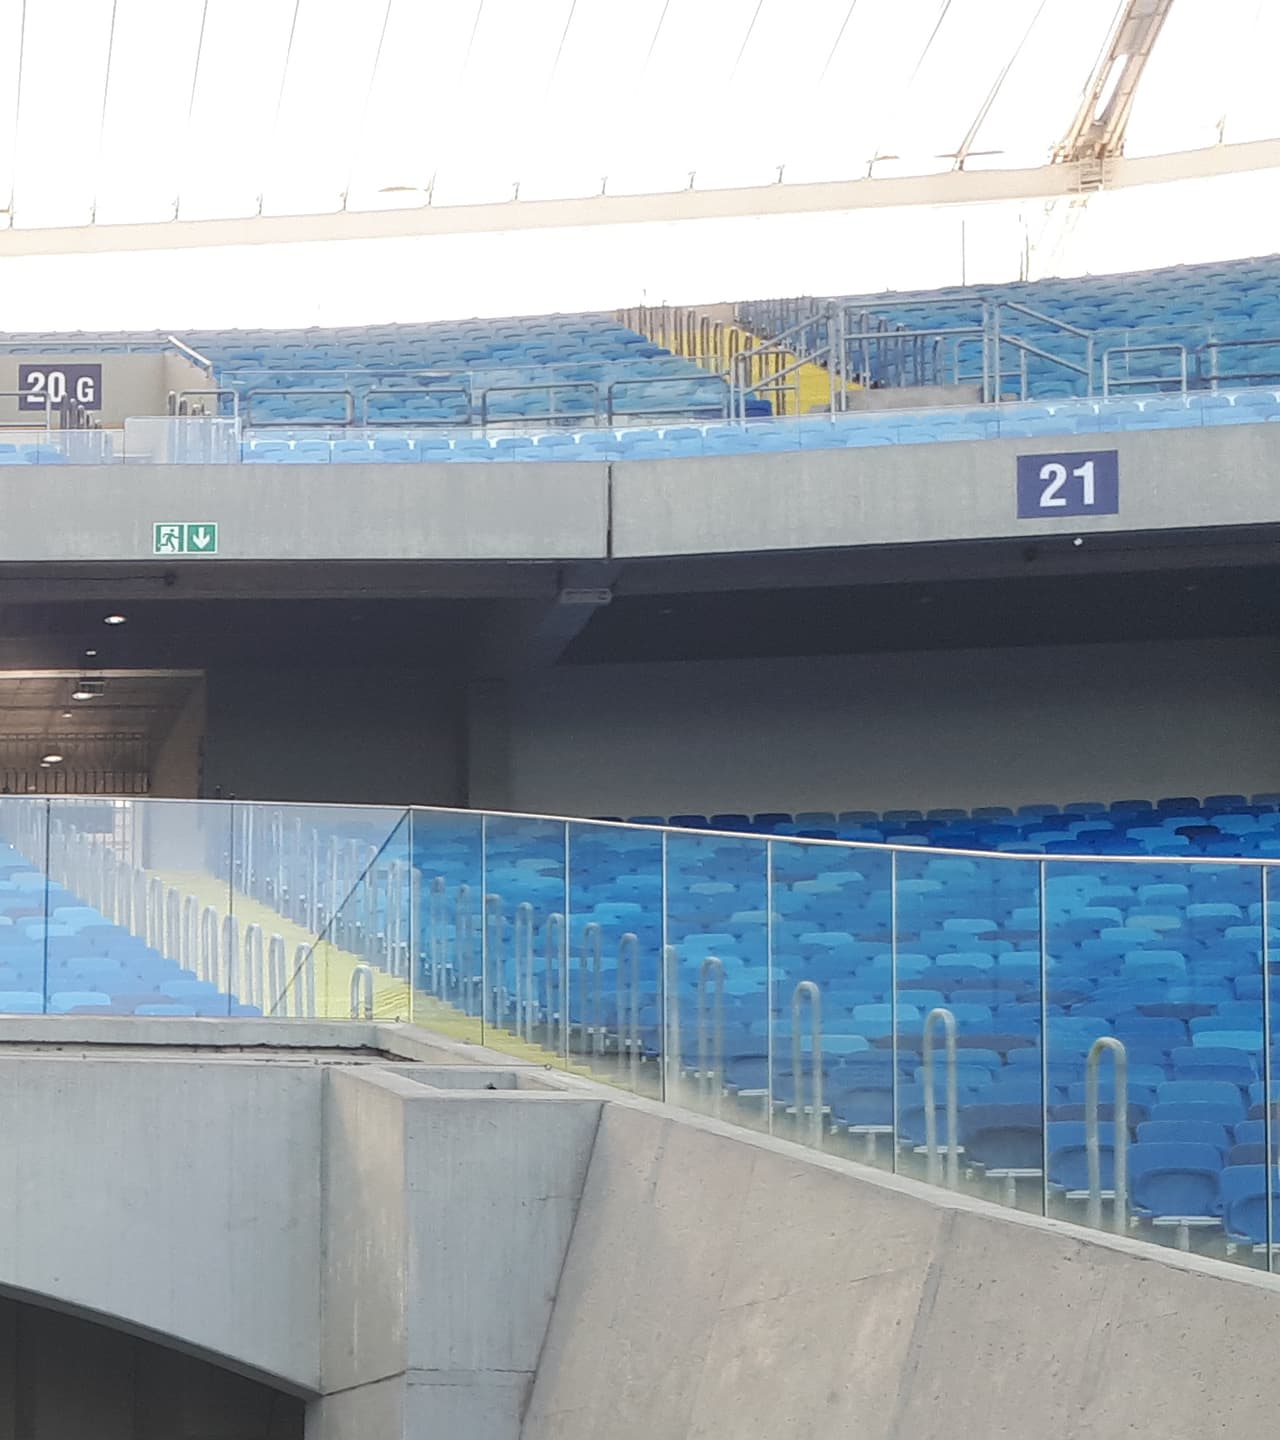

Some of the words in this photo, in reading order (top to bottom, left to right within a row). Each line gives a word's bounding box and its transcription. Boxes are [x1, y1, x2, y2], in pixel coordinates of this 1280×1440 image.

[26, 371, 66, 403] 20
[76, 376, 94, 403] G
[1039, 461, 1094, 507] 21
